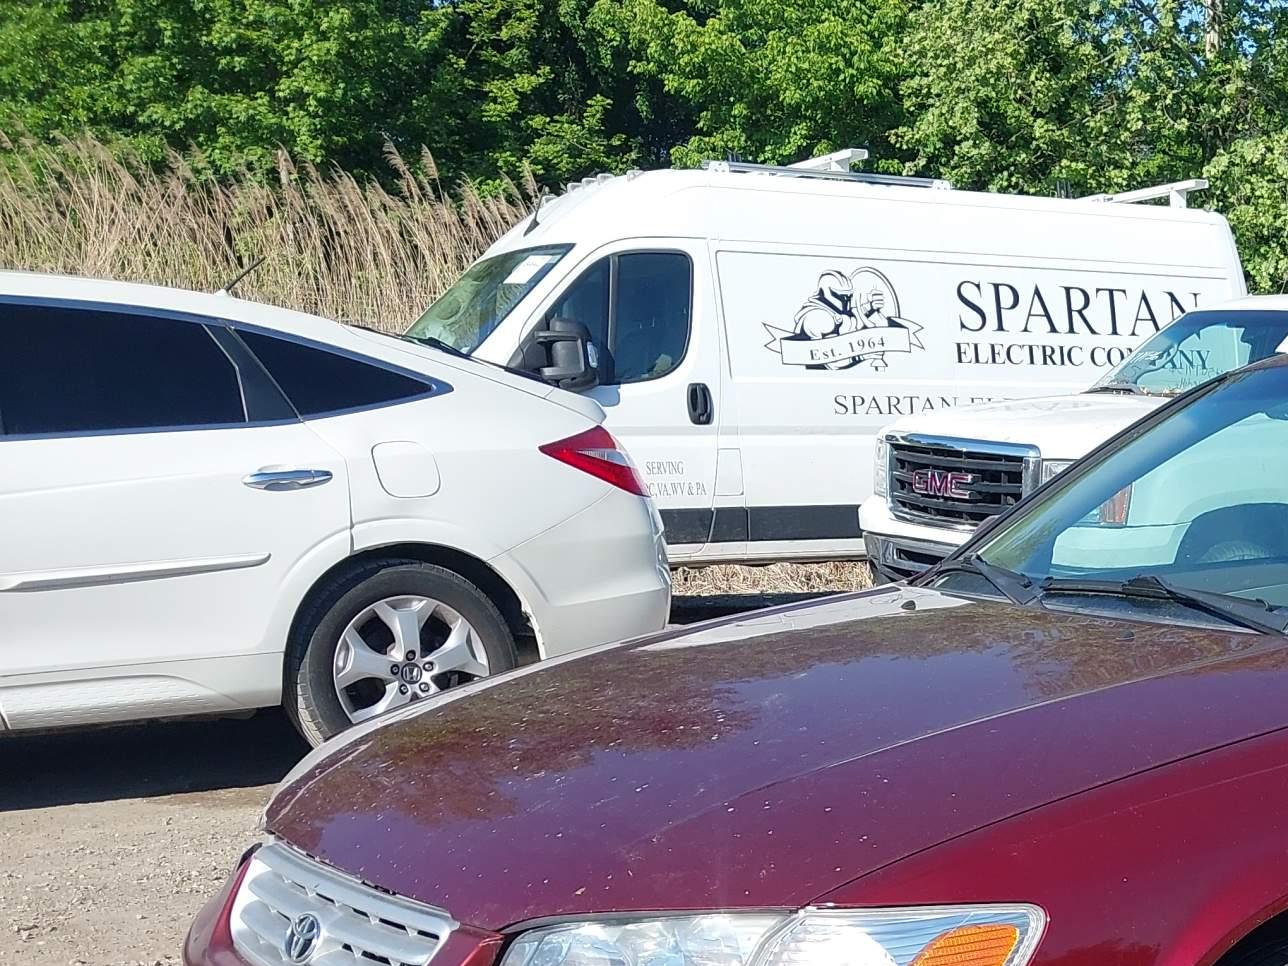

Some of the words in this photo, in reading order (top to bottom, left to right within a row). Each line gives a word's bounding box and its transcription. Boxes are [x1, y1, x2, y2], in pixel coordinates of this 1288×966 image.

[956, 281, 1201, 337] SPARTAN
[809, 347, 842, 361] Est.
[848, 336, 885, 353] 1964
[955, 342, 1083, 367] ELECTRIC
[1090, 346, 1210, 370] COANY
[834, 394, 959, 415] SPARTAN
[645, 461, 684, 475] SERVING
[687, 481, 695, 496] &
[696, 481, 707, 495] PA
[912, 470, 973, 499] GMC
